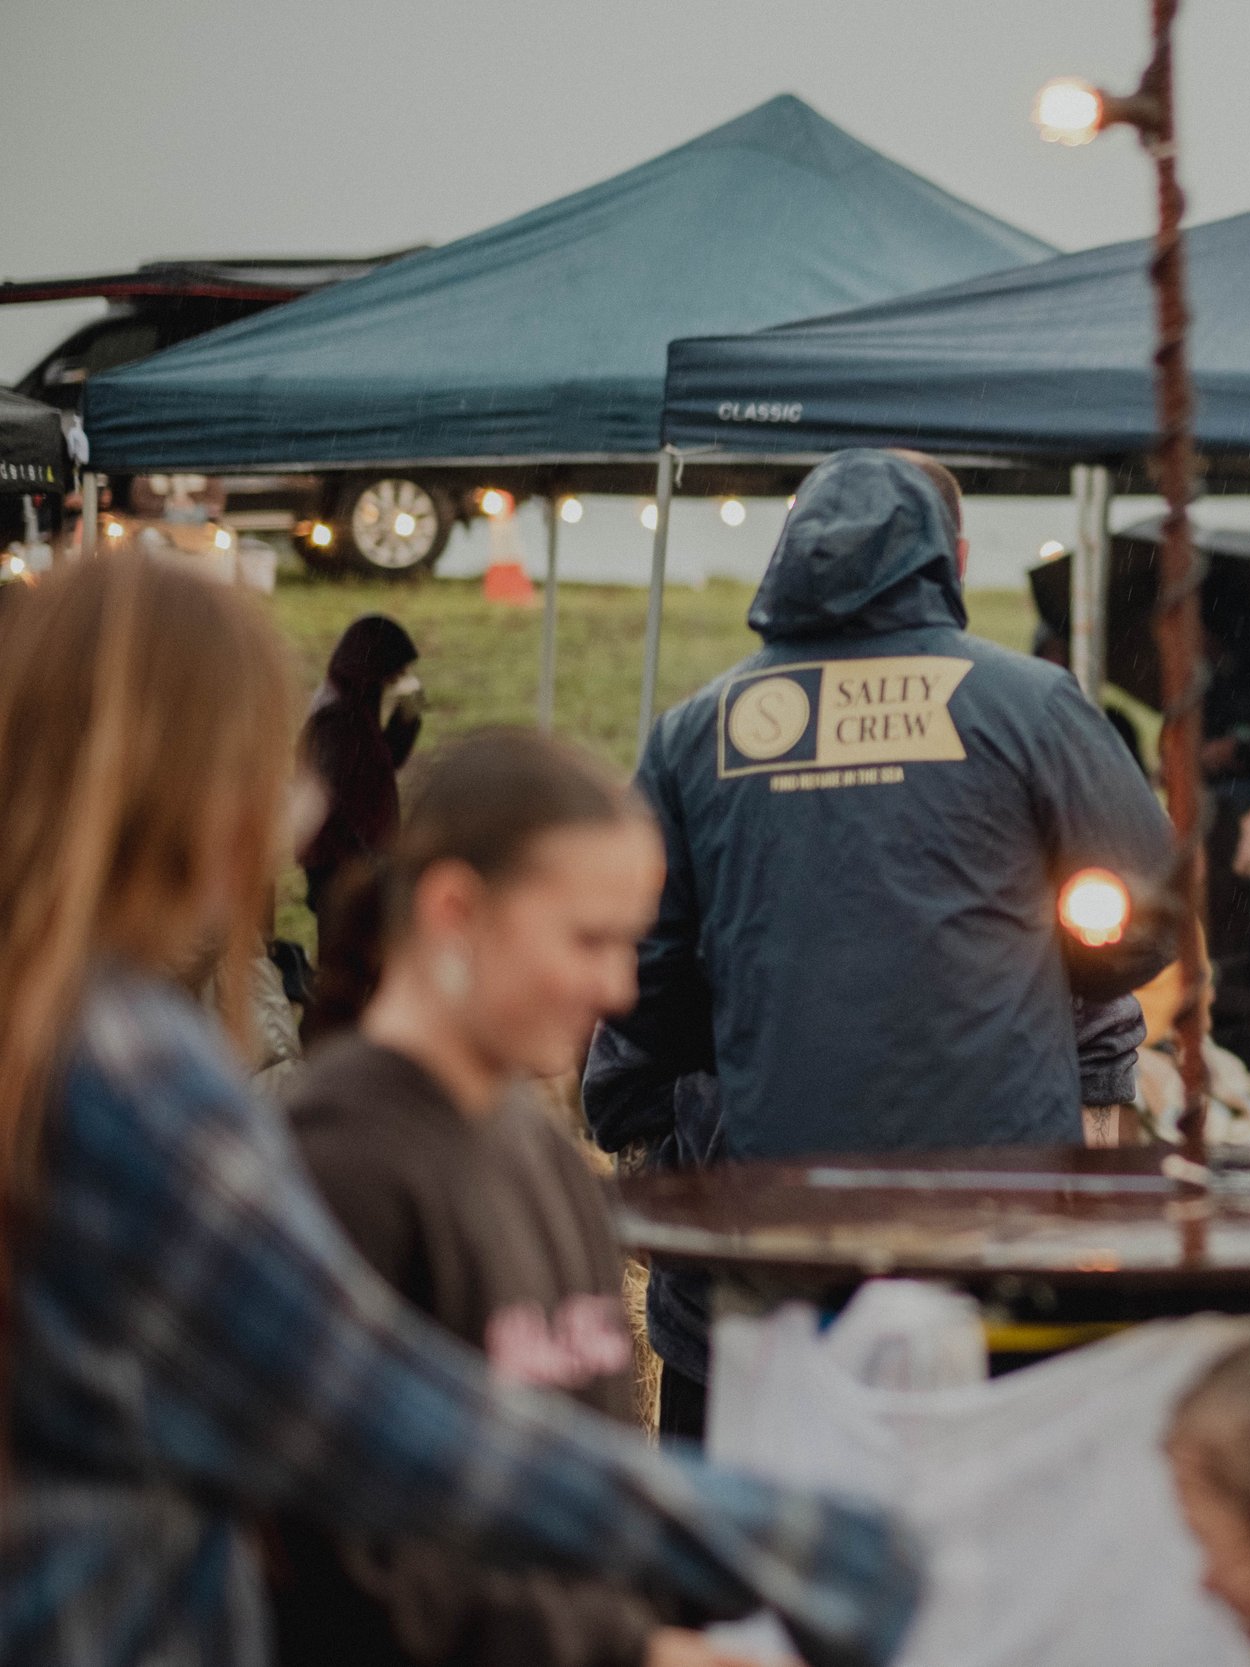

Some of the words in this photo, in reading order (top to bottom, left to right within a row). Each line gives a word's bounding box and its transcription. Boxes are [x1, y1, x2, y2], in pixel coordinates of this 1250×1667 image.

[718, 401, 803, 423] CLASSIC
[837, 674, 940, 707] SALTY
[836, 711, 932, 745] CREW
